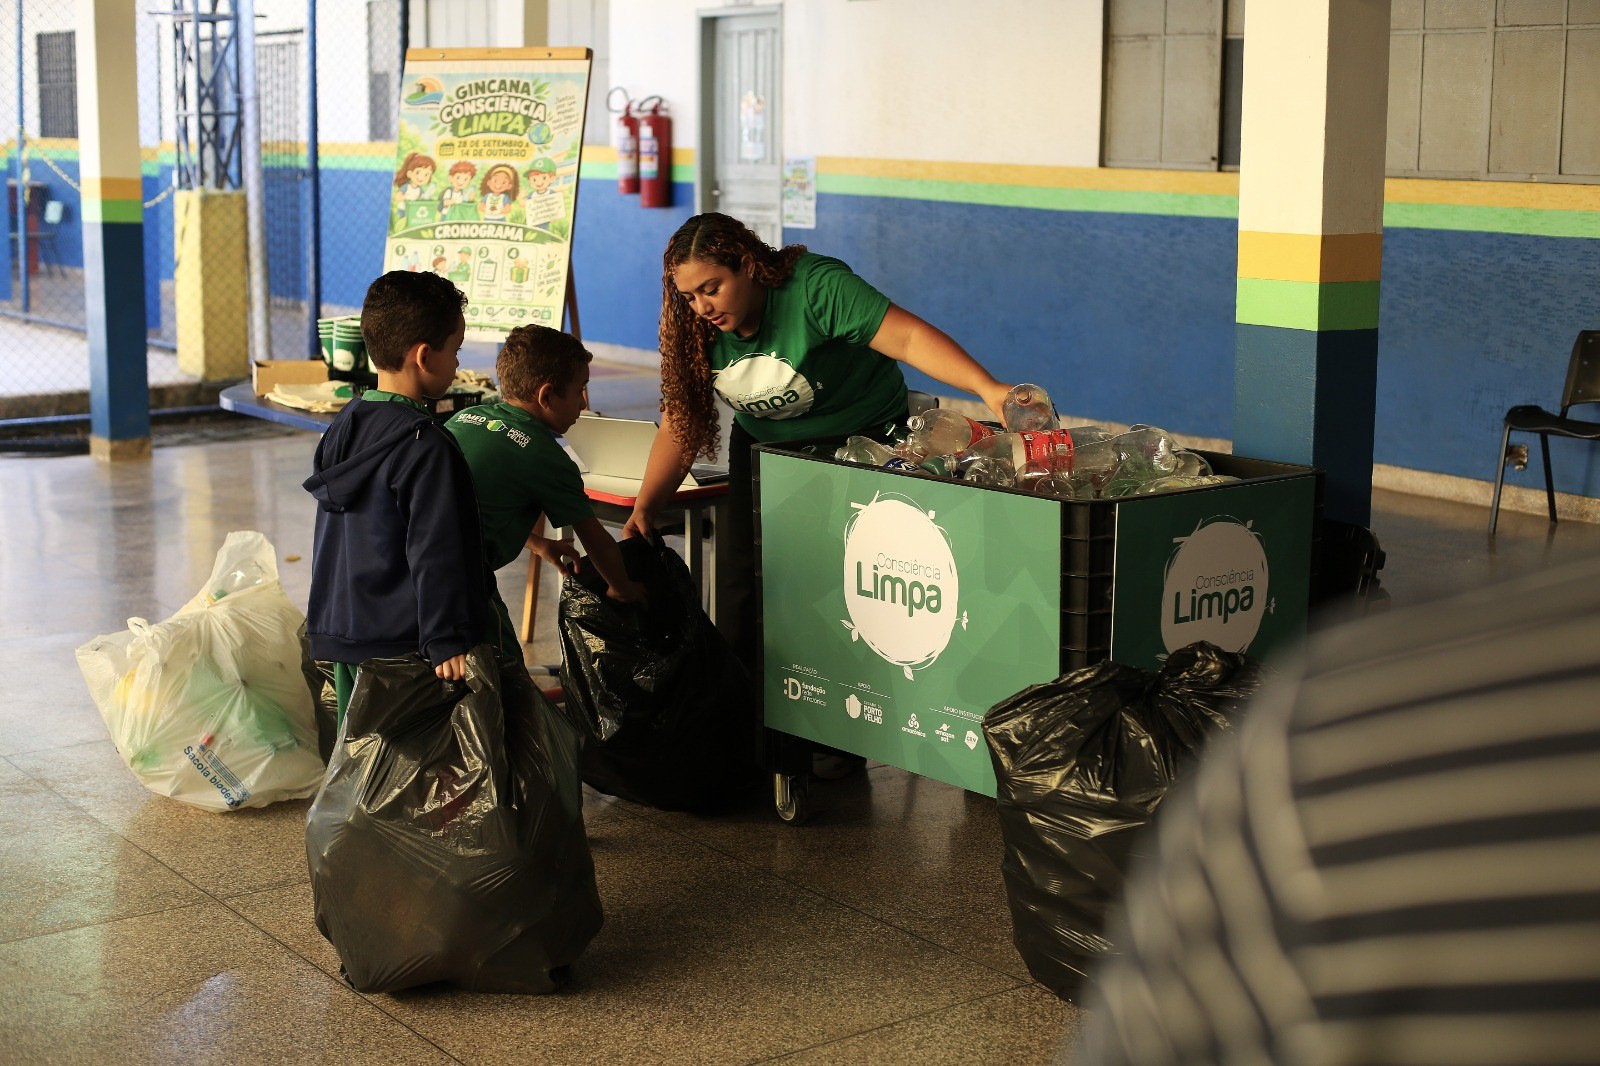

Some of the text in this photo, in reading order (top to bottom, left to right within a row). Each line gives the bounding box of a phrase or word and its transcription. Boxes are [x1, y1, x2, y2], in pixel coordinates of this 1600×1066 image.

[455, 79, 531, 100] GINCANA
[440, 93, 547, 124] CONSCIÊNCIA
[457, 112, 527, 138] LIMPA
[461, 149, 527, 157] 14 DE OUTUBRO
[470, 140, 480, 148] DE
[483, 140, 524, 148] SETEMBRO
[434, 223, 524, 242] CRONOGRAMA
[726, 389, 800, 412] Limpa
[457, 413, 487, 423] SEMED
[877, 552, 941, 580] Consciência
[856, 560, 942, 618] Limpa
[1196, 569, 1254, 590] Consciência
[1174, 585, 1254, 625] Limpa
[863, 704, 882, 716] PORTO
[864, 712, 883, 725] VELHO
[943, 705, 985, 721] APOIO INSTITUCIO
[184, 745, 211, 778] Sacola
